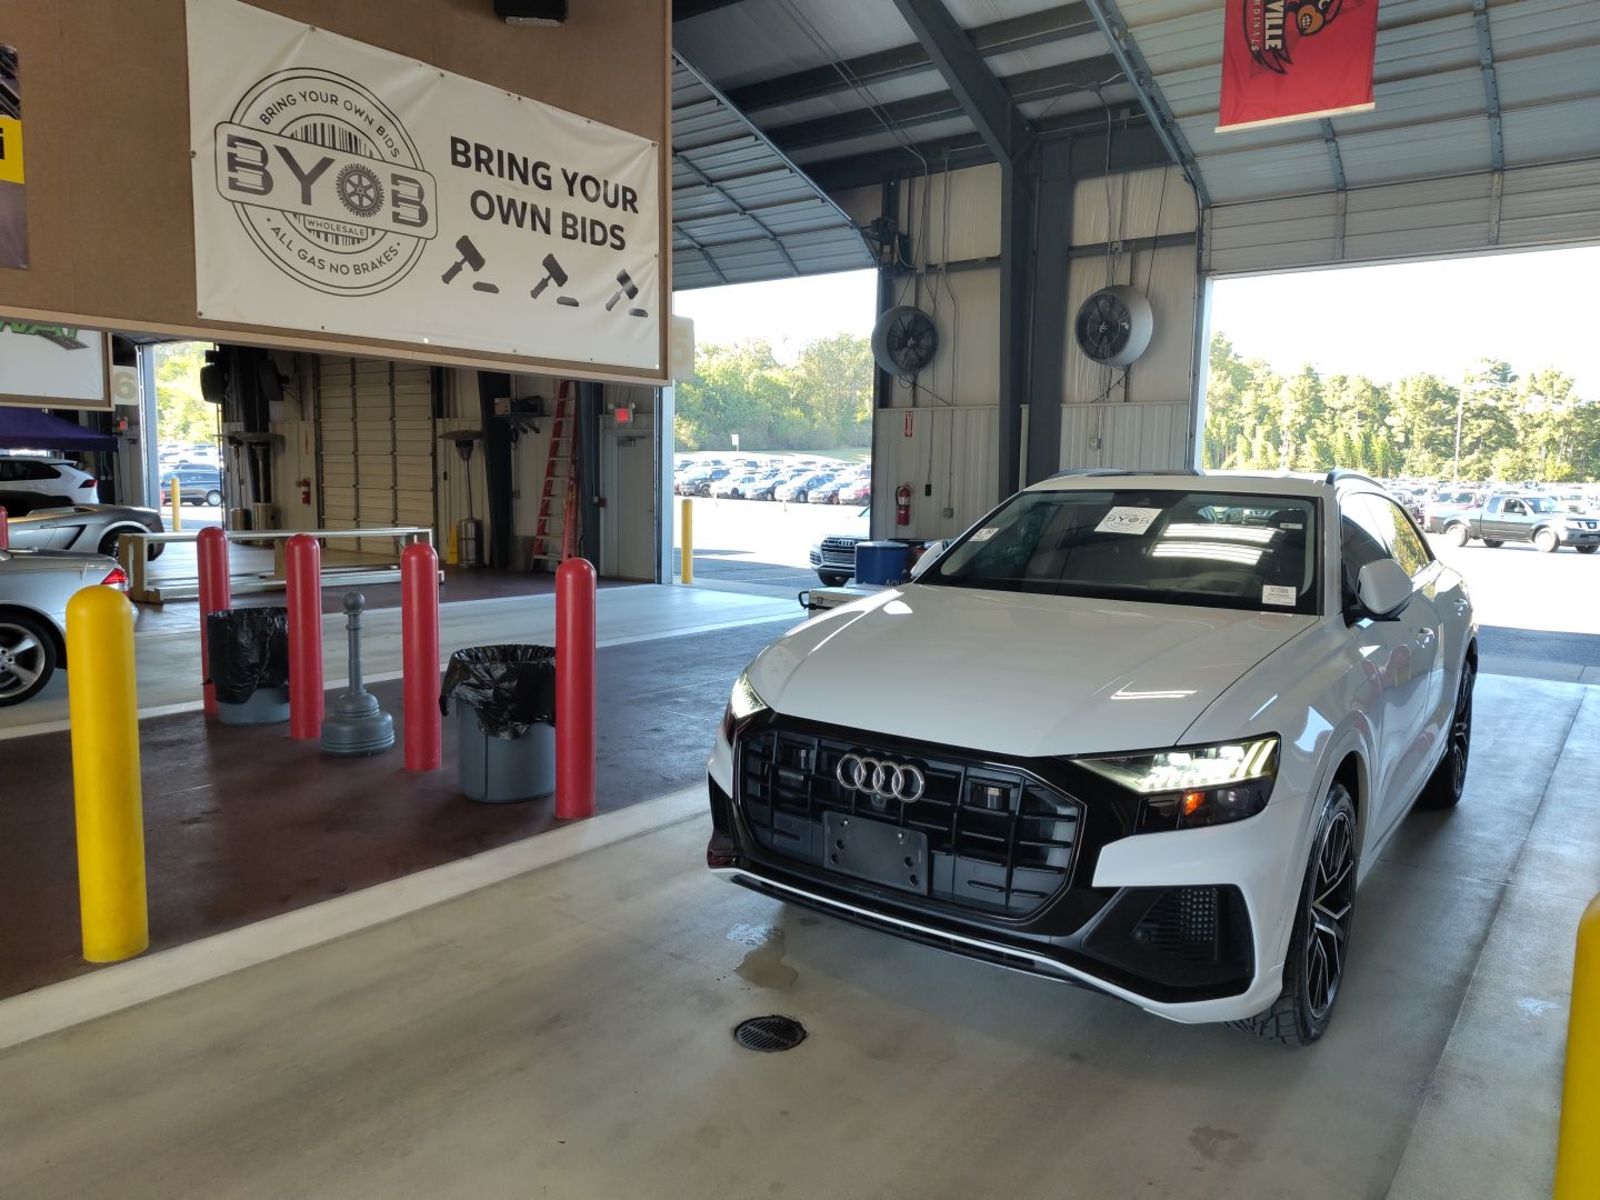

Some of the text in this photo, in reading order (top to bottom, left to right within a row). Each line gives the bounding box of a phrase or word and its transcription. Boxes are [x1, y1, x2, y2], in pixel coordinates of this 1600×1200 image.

[259, 90, 400, 158] BRING YOUR OWN BIDS
[450, 136, 639, 214] BRING YOUR
[307, 219, 365, 237] WHOLESALE
[470, 189, 626, 251] OWN BIDS
[271, 226, 399, 275] ALL GAS NO BRAKES
[112, 371, 137, 399] 6
